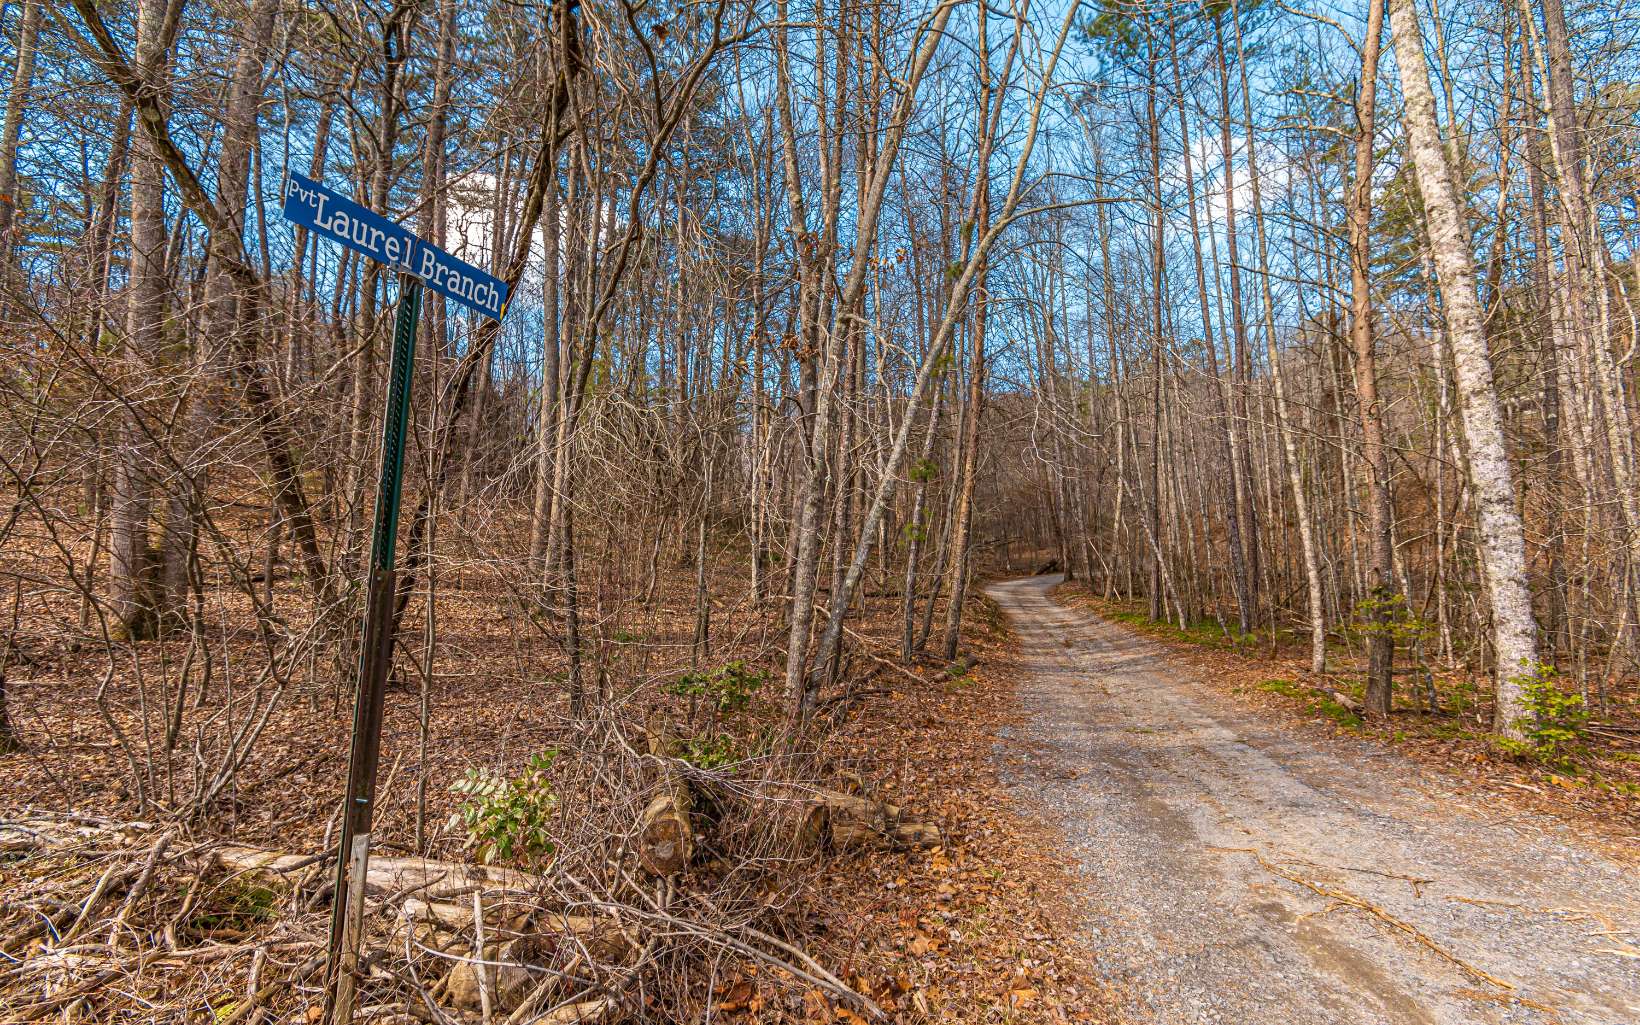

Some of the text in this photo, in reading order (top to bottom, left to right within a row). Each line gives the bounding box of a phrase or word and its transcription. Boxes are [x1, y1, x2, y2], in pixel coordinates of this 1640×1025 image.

[288, 179, 499, 313] Pvt Laurel Branch
